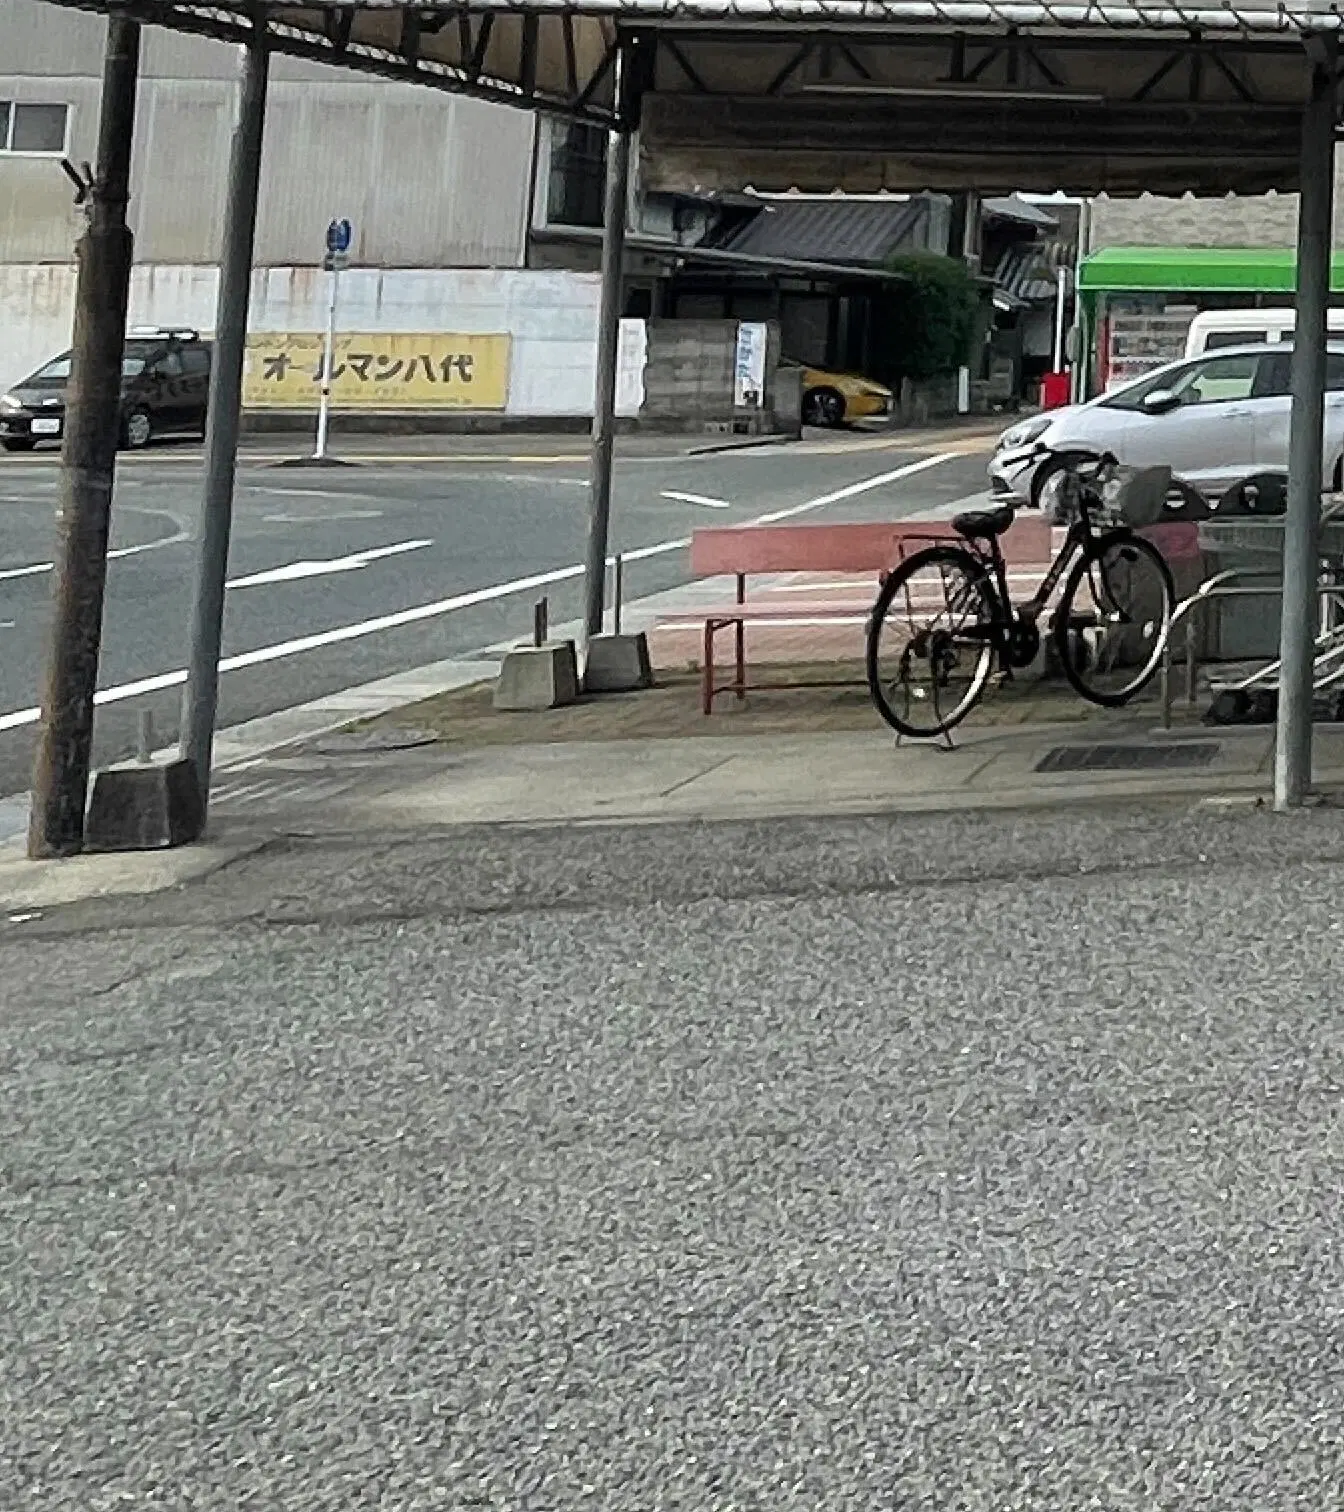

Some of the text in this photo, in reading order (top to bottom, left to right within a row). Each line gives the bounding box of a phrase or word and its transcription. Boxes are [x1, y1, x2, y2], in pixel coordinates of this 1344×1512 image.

[263, 352, 473, 382] オールマン八代
